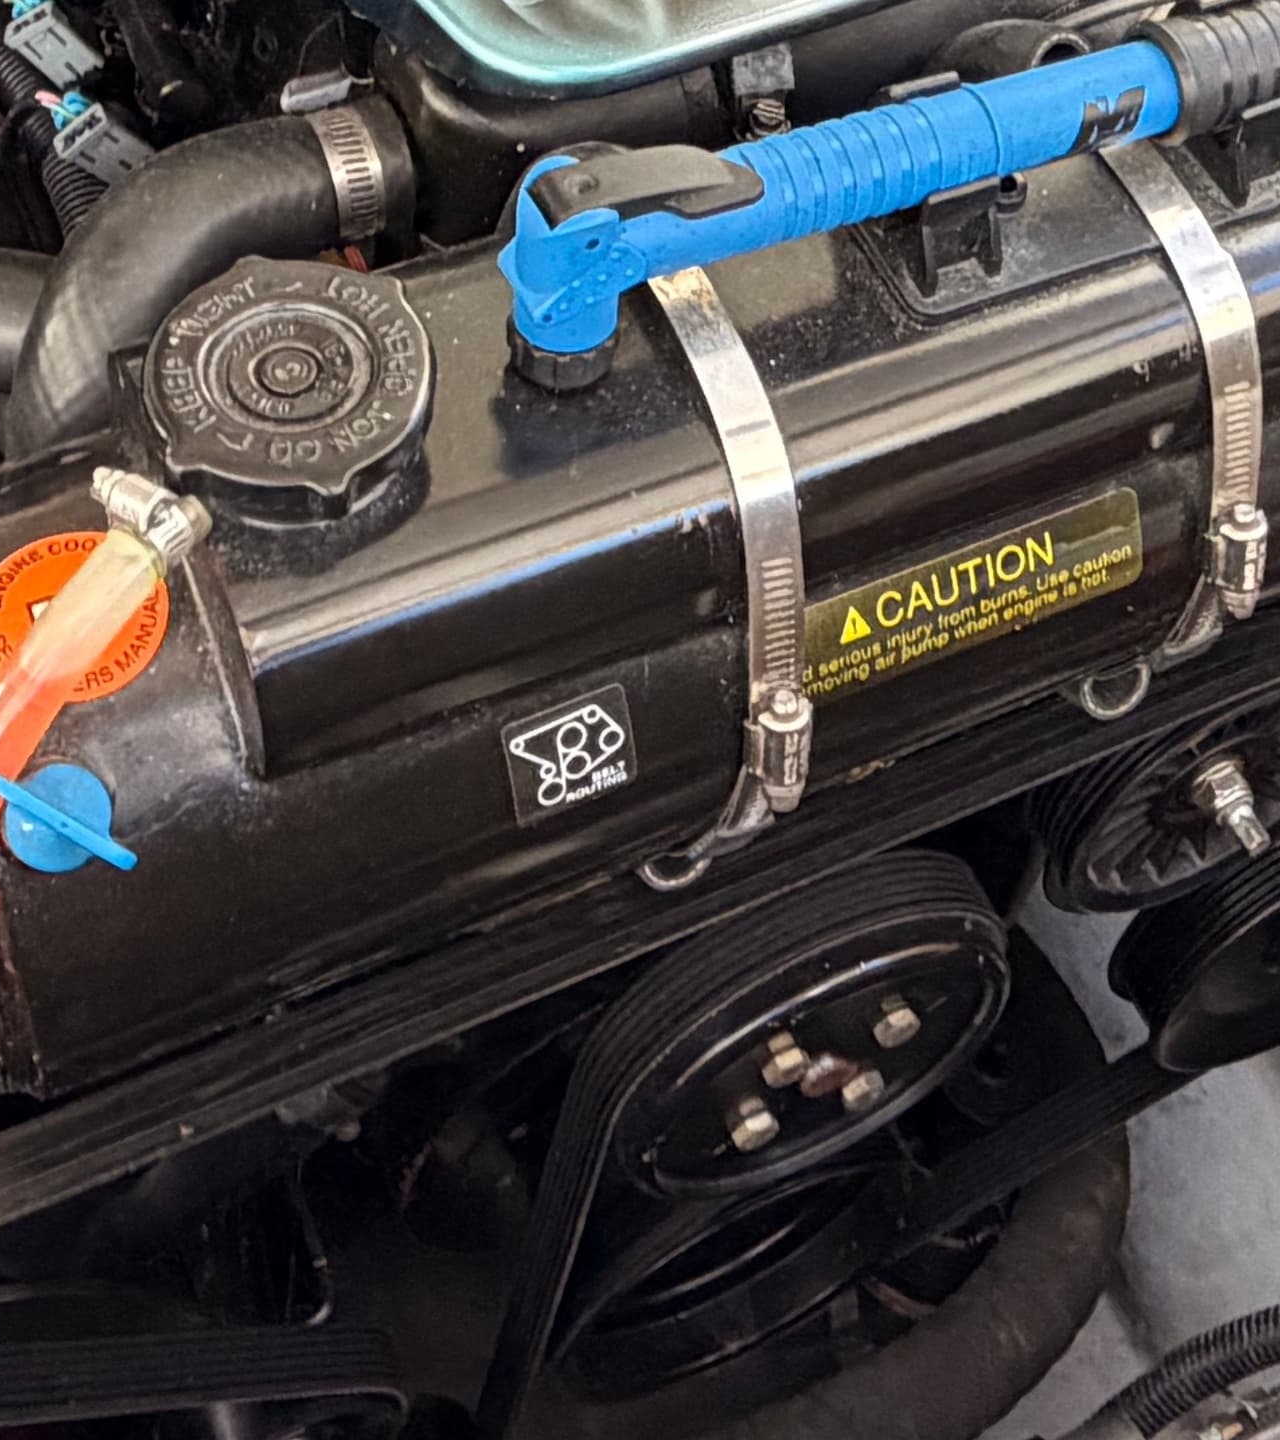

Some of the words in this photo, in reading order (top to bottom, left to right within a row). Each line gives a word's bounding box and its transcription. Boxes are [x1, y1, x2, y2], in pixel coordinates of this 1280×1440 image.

[818, 639, 882, 675] serious
[886, 620, 934, 656] injury
[937, 604, 977, 627] from
[1036, 570, 1070, 594] Use
[1072, 543, 1133, 577] caution
[874, 649, 896, 673] air
[899, 631, 950, 668] pump
[953, 613, 999, 641] when
[1003, 589, 1060, 627] engine
[1063, 582, 1078, 598] is
[1081, 569, 1112, 594] hot.
[876, 530, 1055, 628] CAUTION
[565, 771, 628, 804] ROUTING
[591, 760, 626, 783] BELT
